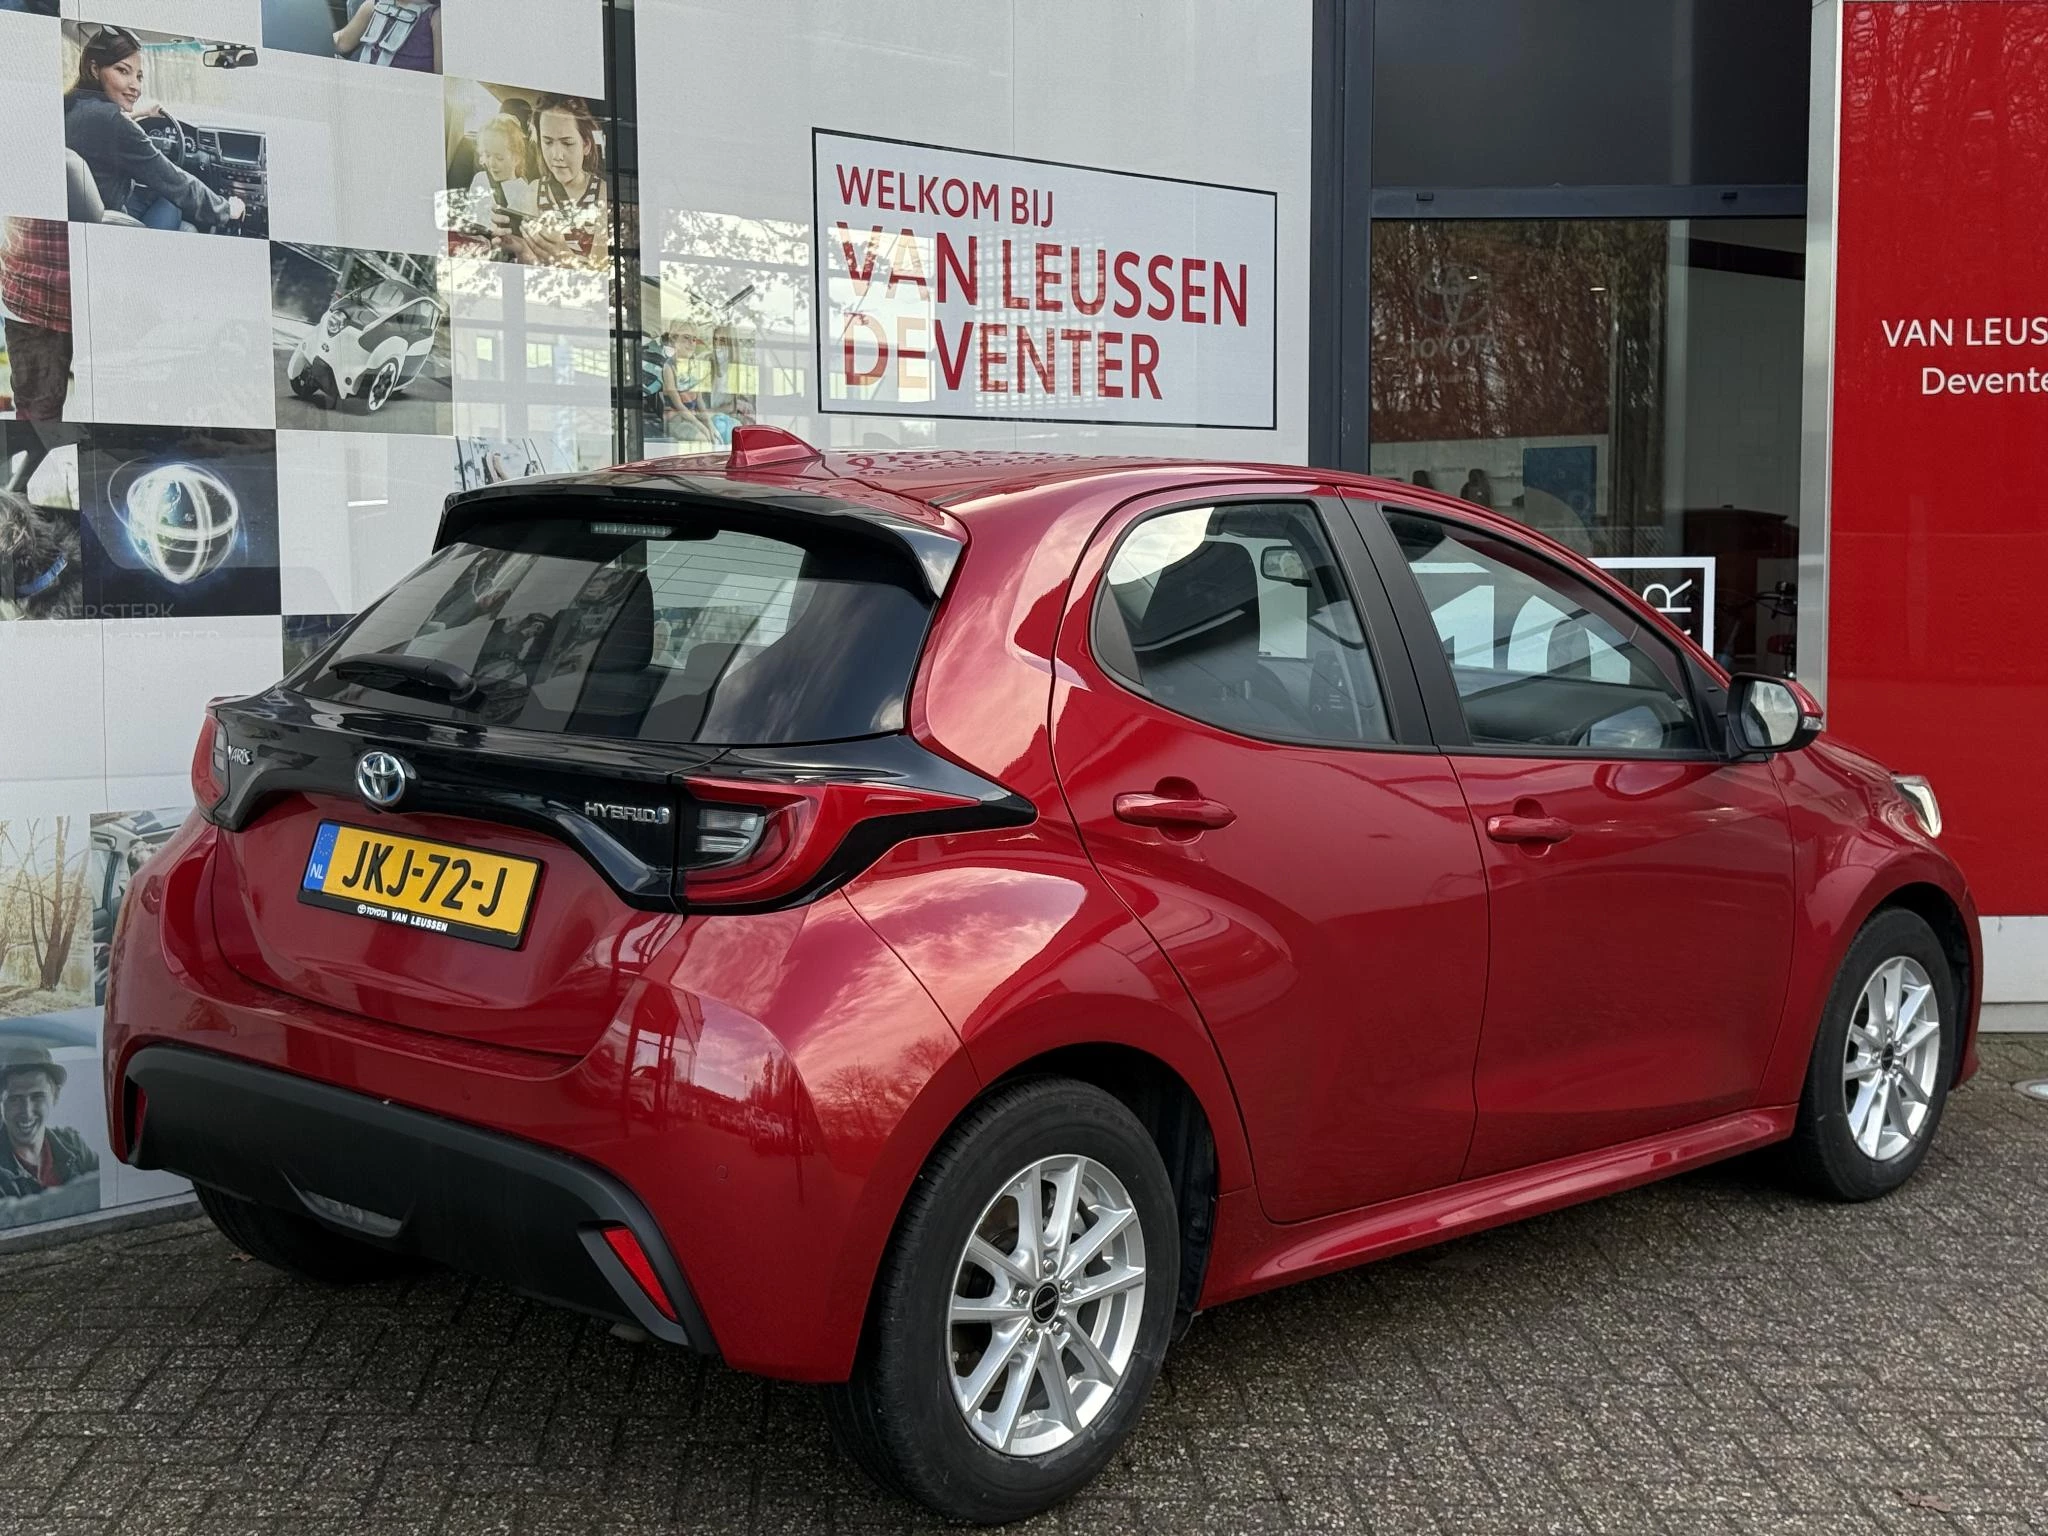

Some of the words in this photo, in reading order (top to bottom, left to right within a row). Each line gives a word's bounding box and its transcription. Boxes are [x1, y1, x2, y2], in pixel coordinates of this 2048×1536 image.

[836, 163, 999, 222] WELKOM
[1011, 186, 1053, 228] BIJ
[836, 221, 977, 306] VAN
[1003, 239, 1247, 327] LEUSSEN
[843, 311, 1163, 400] DEVENTER
[1881, 318, 1953, 347] VAN
[584, 801, 656, 822] HYBRID
[310, 863, 323, 879] NL
[341, 840, 508, 917] JKJ-72-J
[366, 906, 388, 918] TOYOTA
[392, 911, 408, 923] VAN
[411, 915, 449, 932] LEUSSEN
